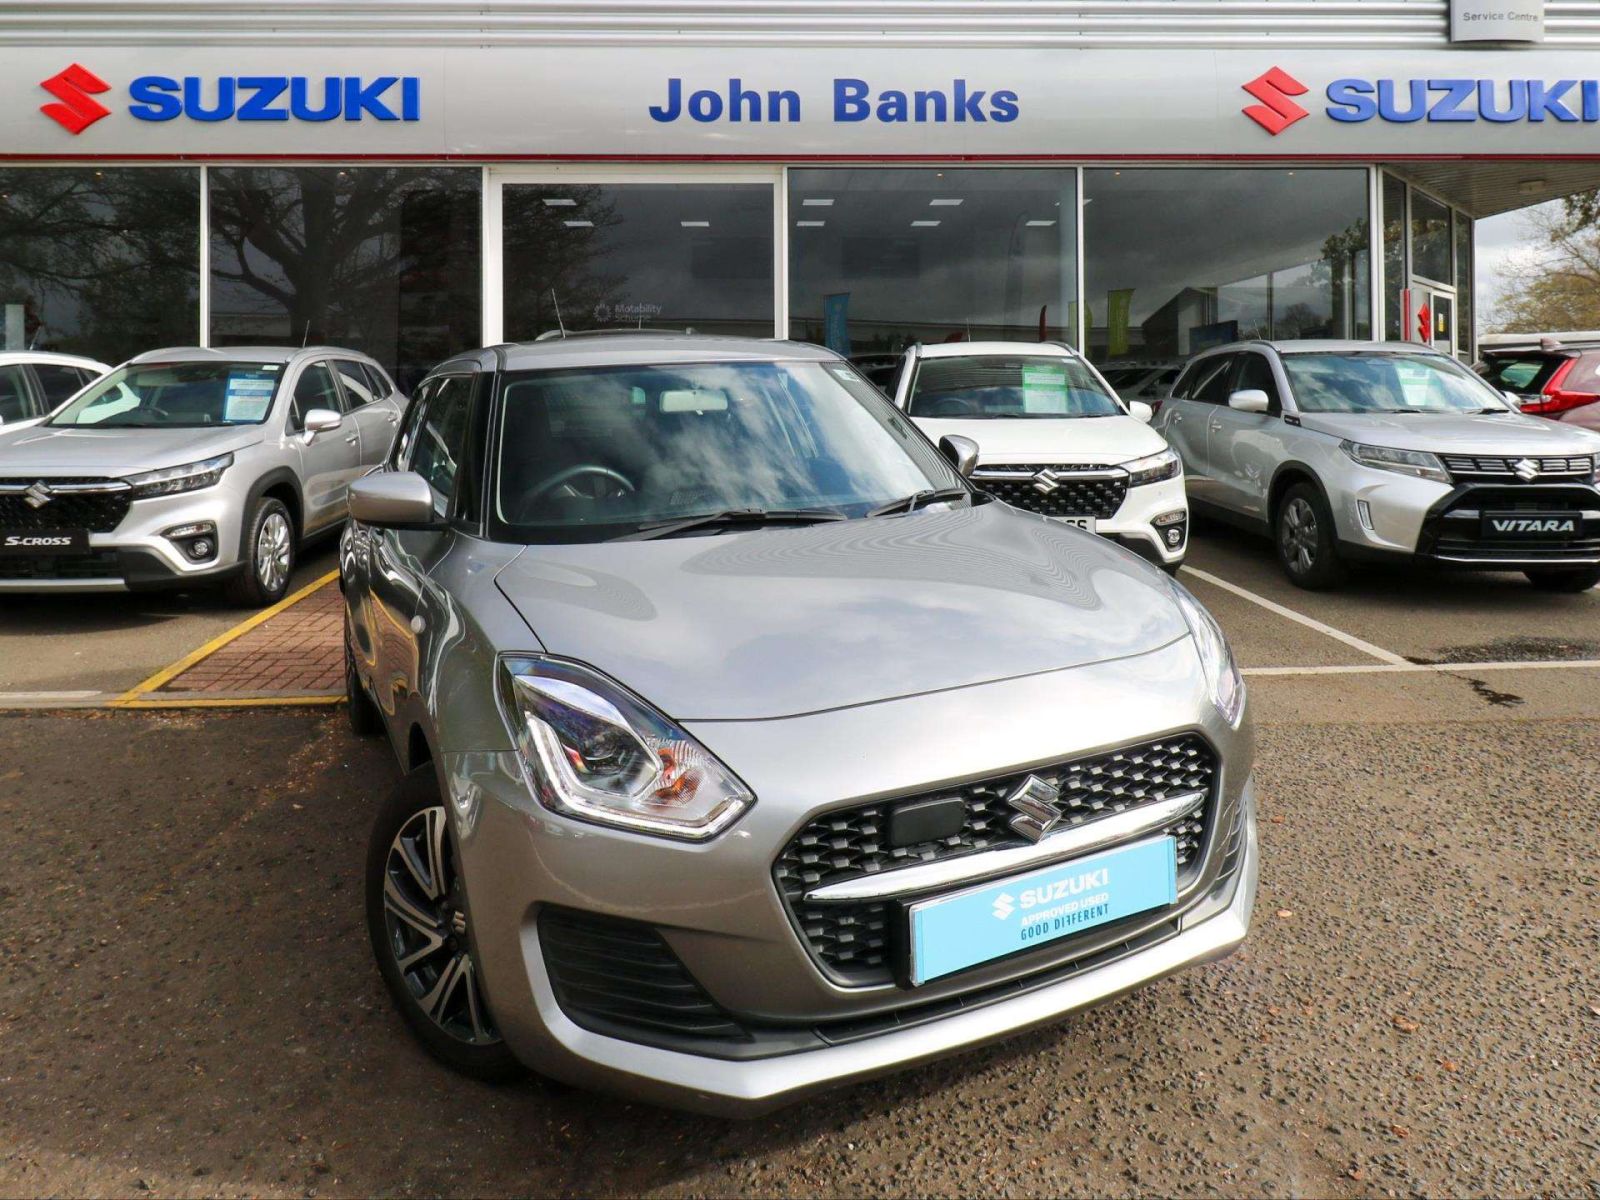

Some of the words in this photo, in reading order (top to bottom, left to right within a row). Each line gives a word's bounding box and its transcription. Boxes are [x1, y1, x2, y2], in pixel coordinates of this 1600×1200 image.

[1463, 12, 1504, 22] Service
[1508, 12, 1538, 22] Centre
[129, 76, 419, 121] SUZUKI
[649, 78, 800, 122] John
[834, 79, 1019, 122] Banks
[1326, 78, 1600, 122] SUZUKI
[615, 304, 661, 314] Motability
[4, 536, 72, 546] S-CROSS
[1492, 520, 1574, 531] VITARA
[1020, 868, 1108, 909] SUZUKI
[1021, 922, 1049, 940] GOOD
[1054, 903, 1108, 929] DIFFERENT
[1022, 901, 1079, 925] APPROVED
[1081, 892, 1109, 907] USED
